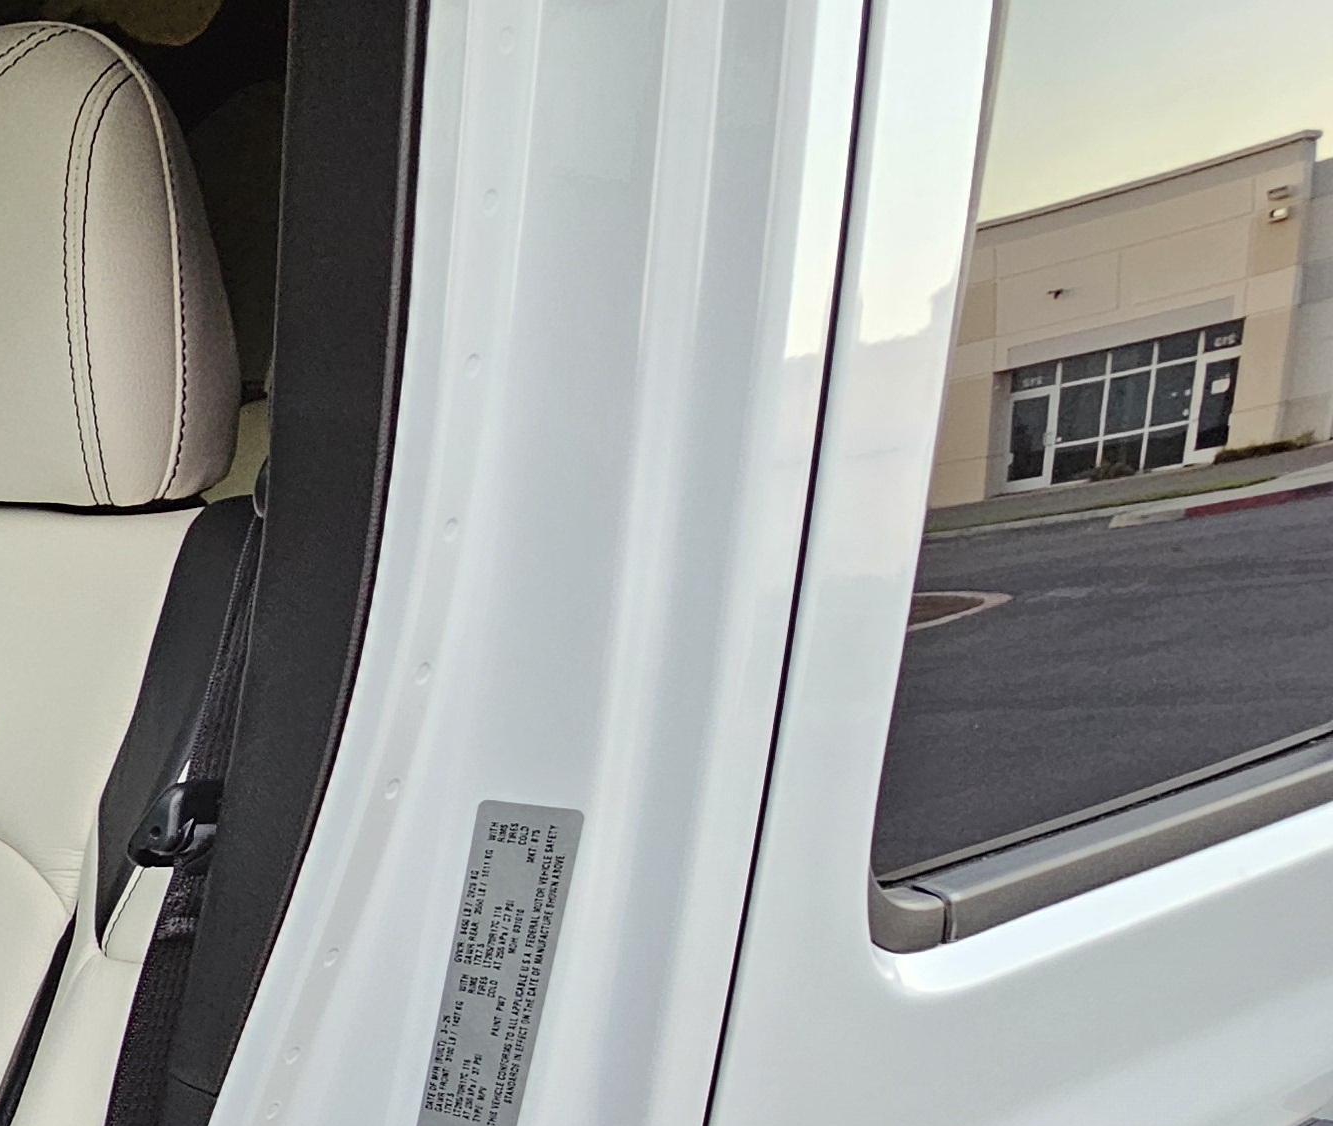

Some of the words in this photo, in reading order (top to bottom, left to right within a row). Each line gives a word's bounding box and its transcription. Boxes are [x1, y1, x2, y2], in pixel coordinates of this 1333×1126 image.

[488, 822, 498, 841] WITH
[497, 824, 509, 842] RIMS
[507, 823, 519, 843] TIRES
[544, 825, 557, 853] SAFETY
[484, 850, 494, 859] KG
[538, 855, 553, 885] VEHICLE
[493, 961, 502, 970] AT
[518, 826, 529, 845] COLD
[532, 887, 546, 913] MOTOR
[545, 881, 559, 908] SHOWN
[525, 916, 540, 948] FEDERAL
[534, 911, 553, 964] MANUFACTURE
[531, 967, 541, 976] OF
[459, 974, 469, 992] WITH
[527, 978, 539, 997] DATE
[511, 974, 528, 1016] APPLICABLE
[523, 998, 534, 1012] THE
[508, 1018, 518, 1030] ALL
[521, 1014, 530, 1024] ON
[505, 1032, 515, 1041] TO
[515, 1026, 528, 1052] EFFECT
[462, 1110, 470, 1120] AT
[487, 980, 498, 998] COLD
[497, 1043, 512, 1080] CONFORMS
[429, 1082, 437, 1091] OF
[503, 1063, 520, 1104] STANDARDS
[425, 1092, 435, 1110] DATE
[491, 1082, 504, 1109] VEHICLE
[486, 1111, 498, 1126] THIS
